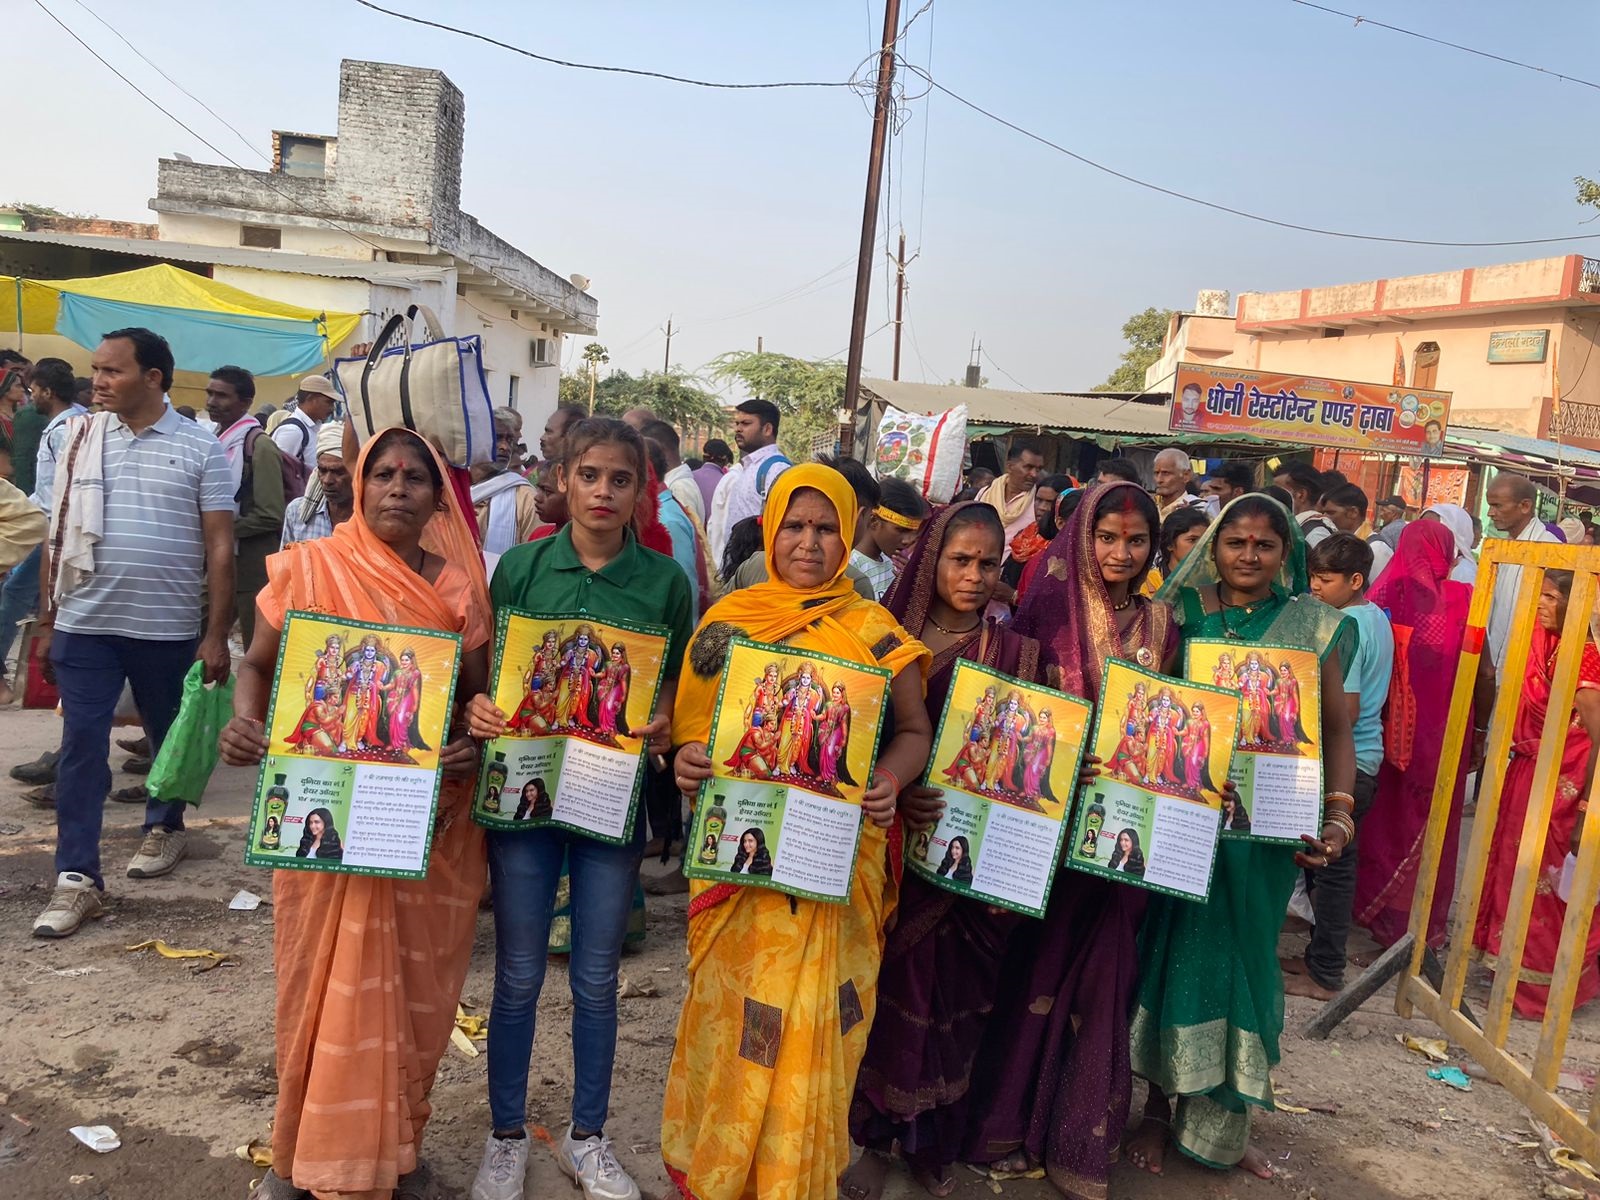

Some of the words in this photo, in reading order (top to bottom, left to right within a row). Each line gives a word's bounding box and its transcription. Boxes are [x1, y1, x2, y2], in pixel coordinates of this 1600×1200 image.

[1206, 381, 1245, 417] धोनी
[1247, 386, 1317, 424] रेस्टोरेन्ट
[1320, 400, 1357, 428] एण्ड
[301, 776, 321, 787] दुनिया
[737, 799, 756, 807] दुनिया
